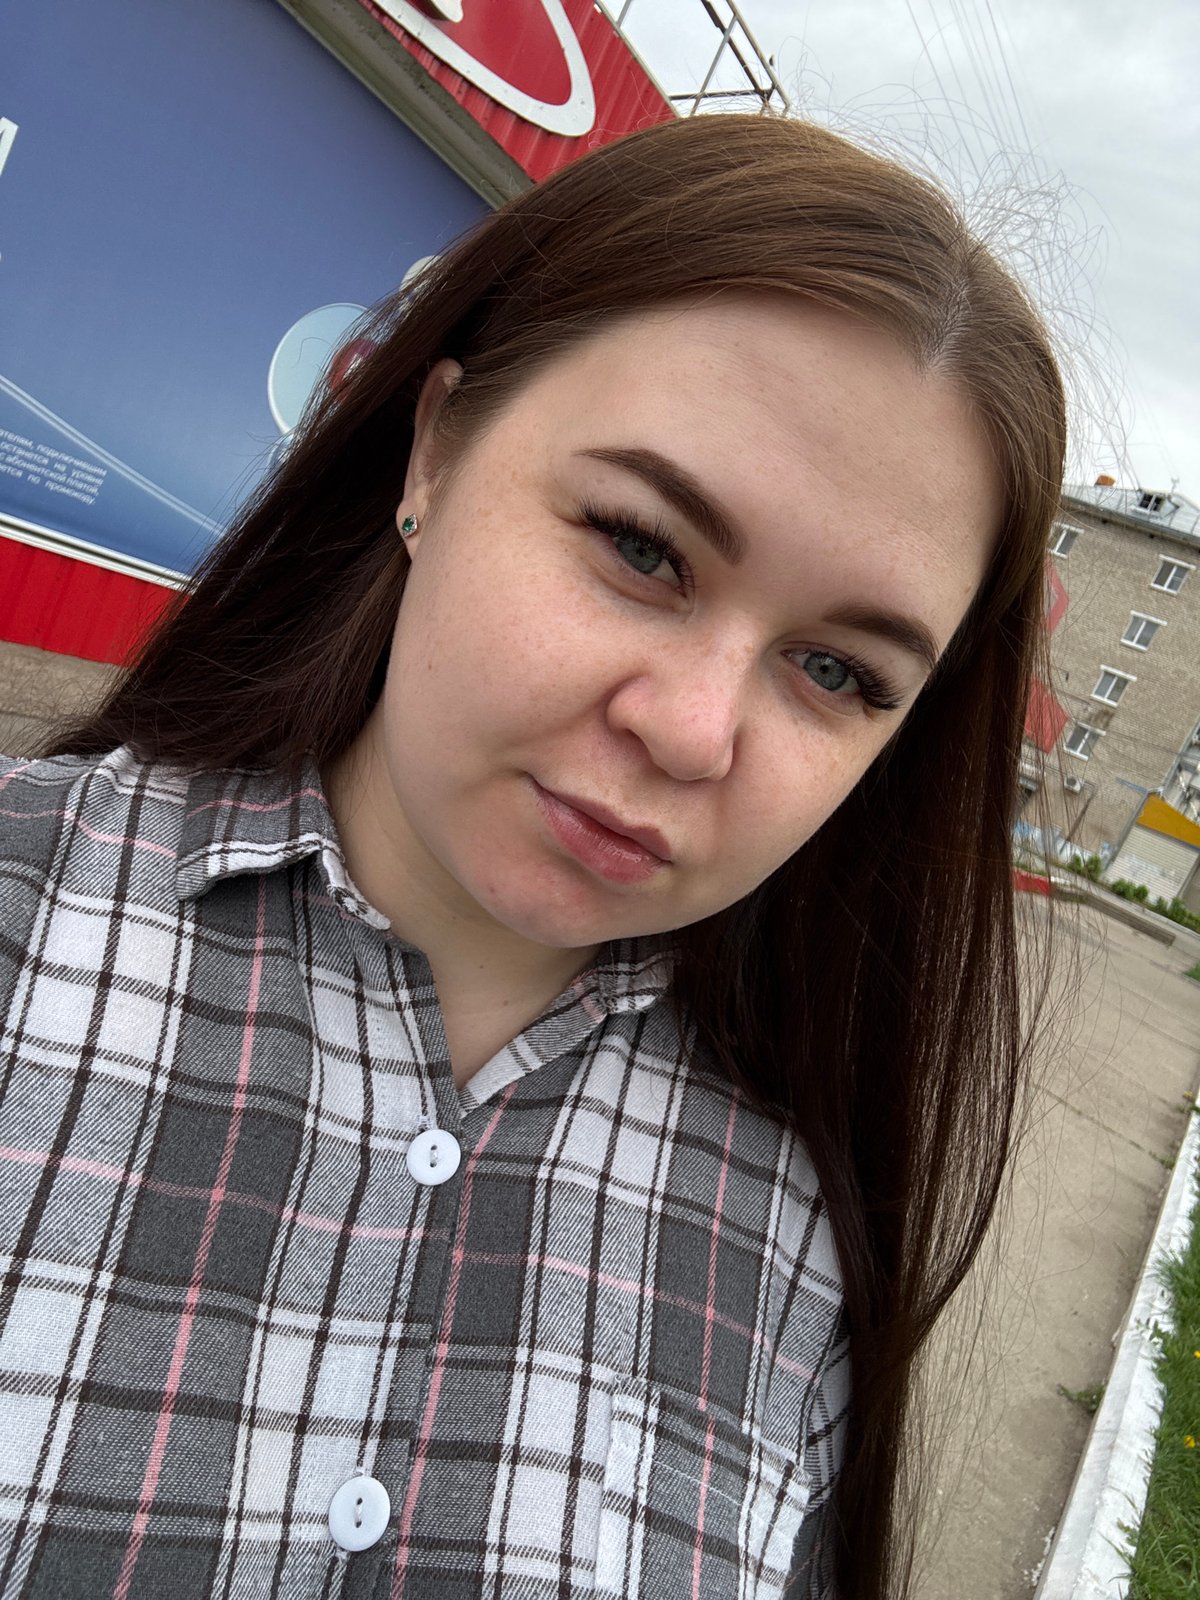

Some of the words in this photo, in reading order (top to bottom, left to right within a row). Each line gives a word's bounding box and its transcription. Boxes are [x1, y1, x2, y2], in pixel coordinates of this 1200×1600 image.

[5, 454, 67, 483] абонентской
[54, 462, 67, 473] на
[27, 474, 40, 485] по
